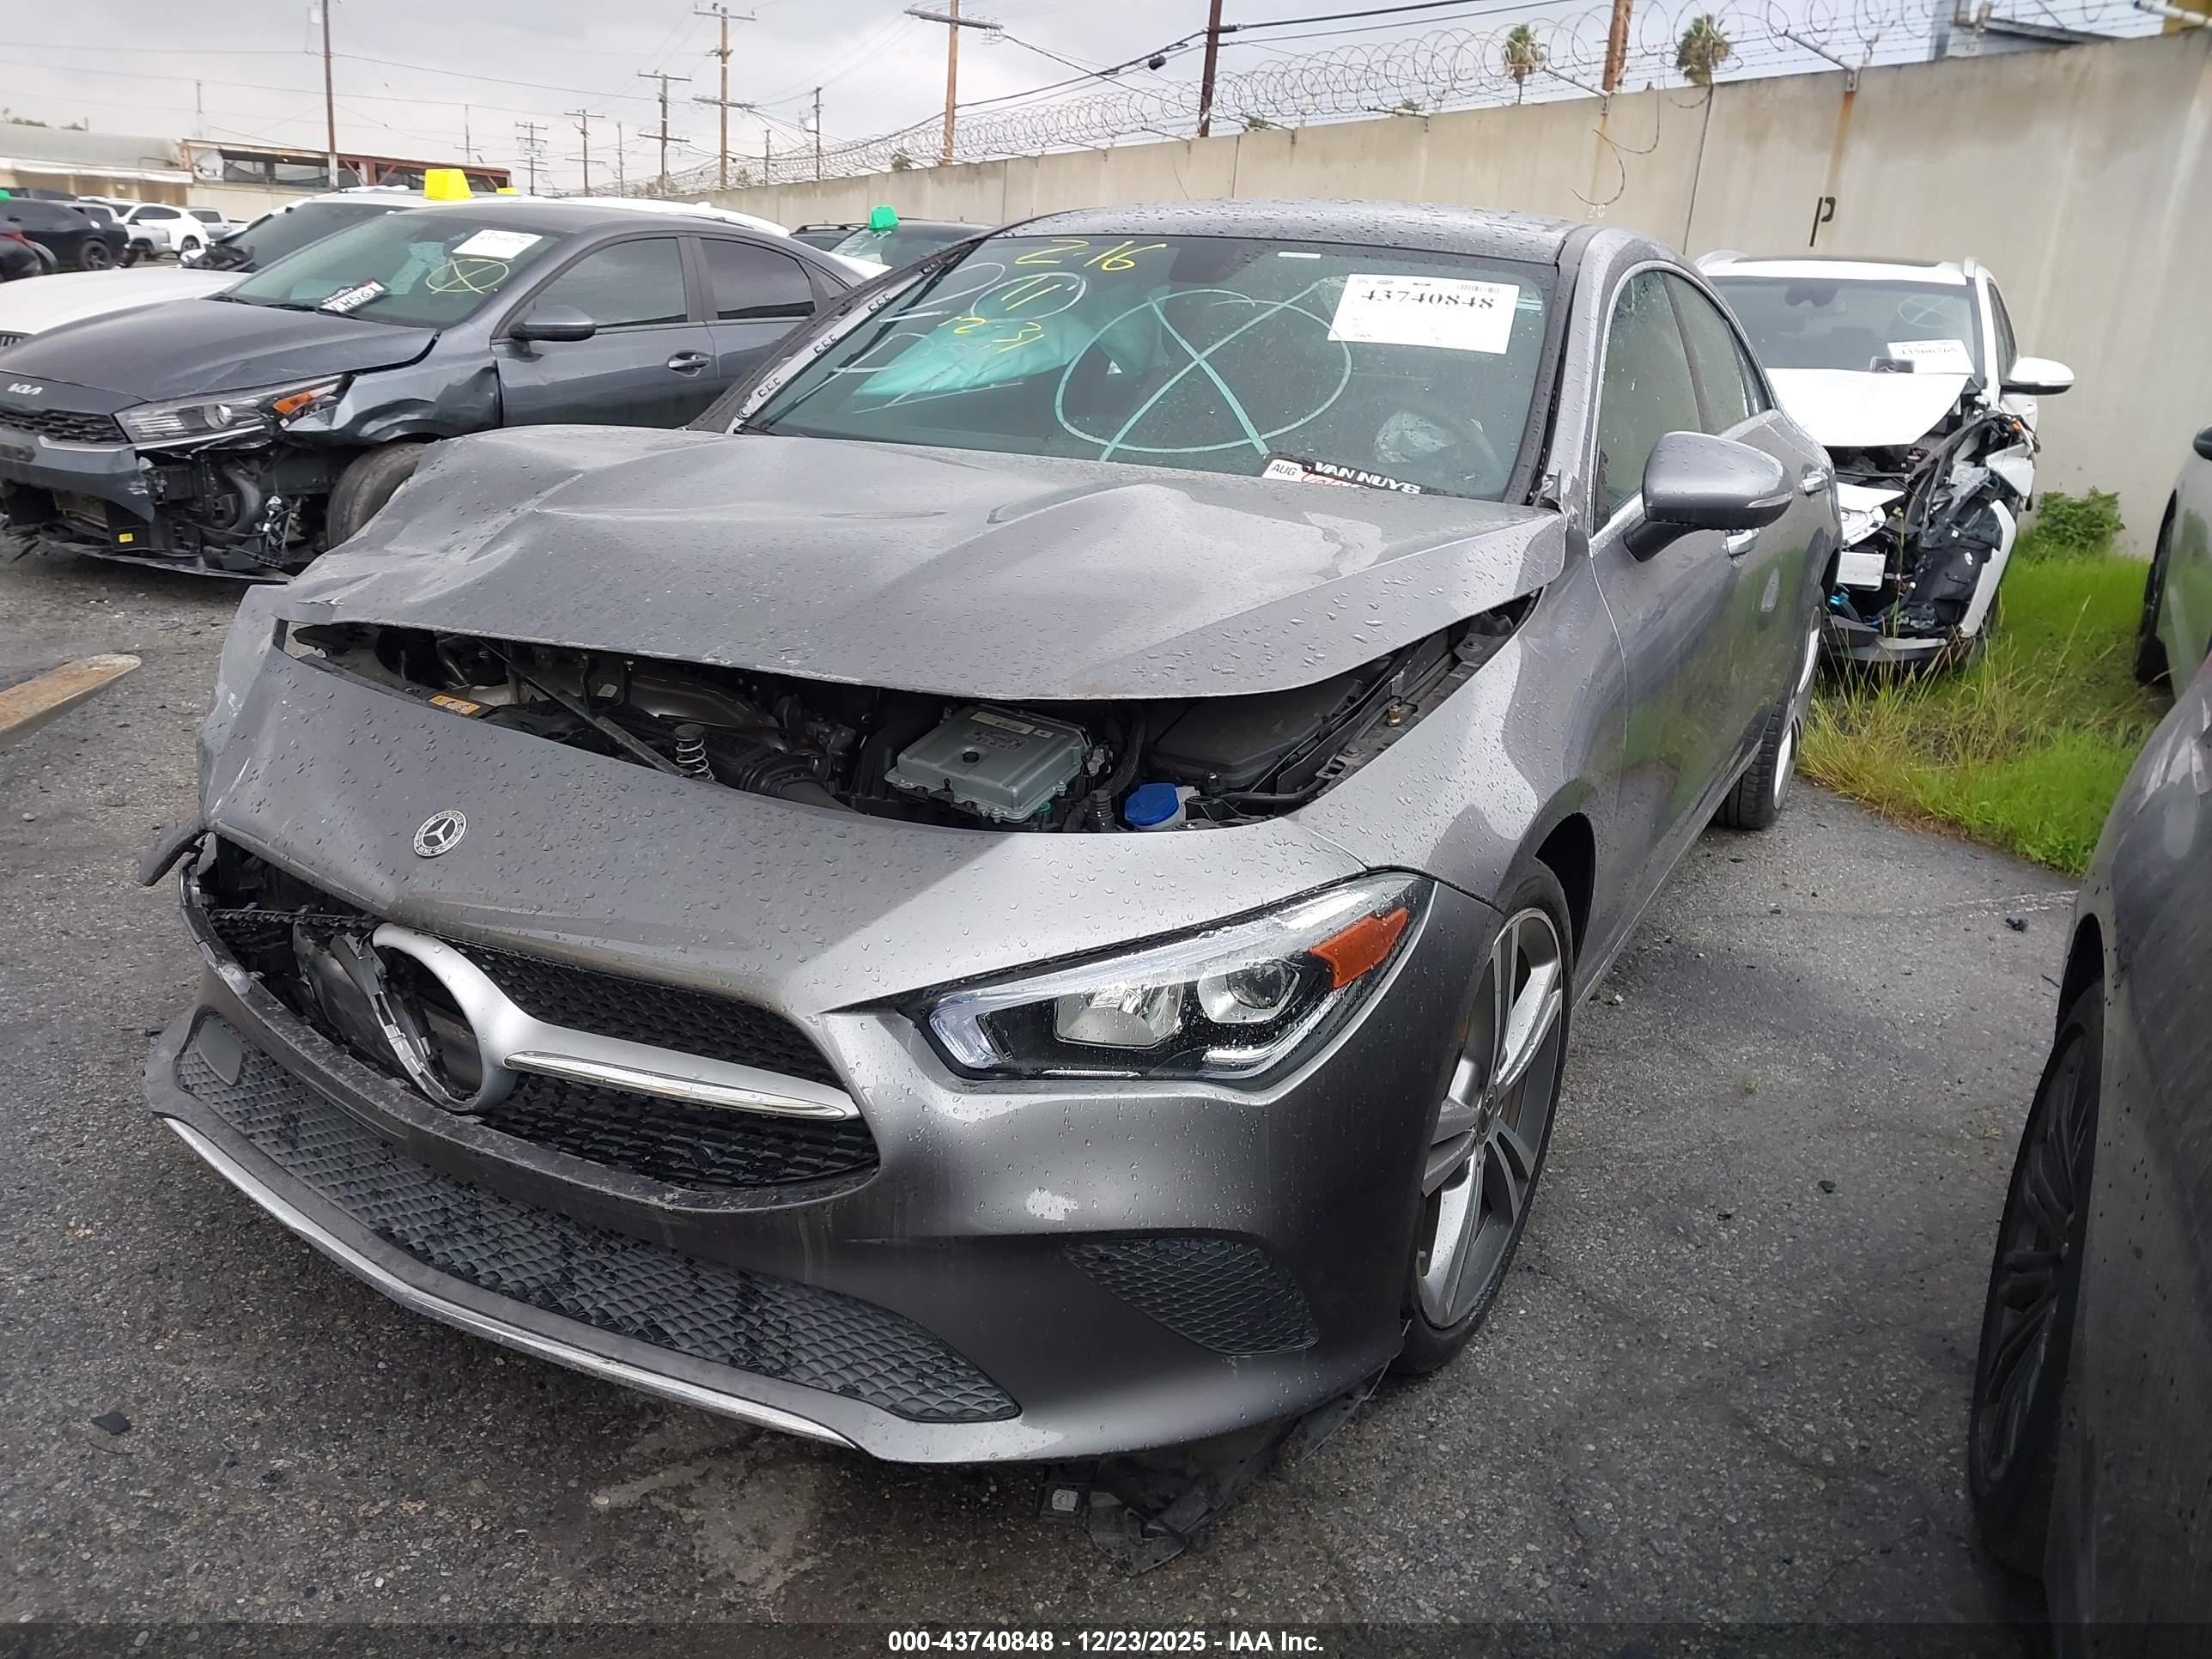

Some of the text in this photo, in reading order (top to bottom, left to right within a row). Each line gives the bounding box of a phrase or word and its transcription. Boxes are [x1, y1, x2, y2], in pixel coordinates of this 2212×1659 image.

[1361, 289, 1495, 310] 43740848
[1271, 463, 1298, 477] AUG
[1315, 461, 1357, 479] VAN
[1356, 471, 1422, 495] NUYS
